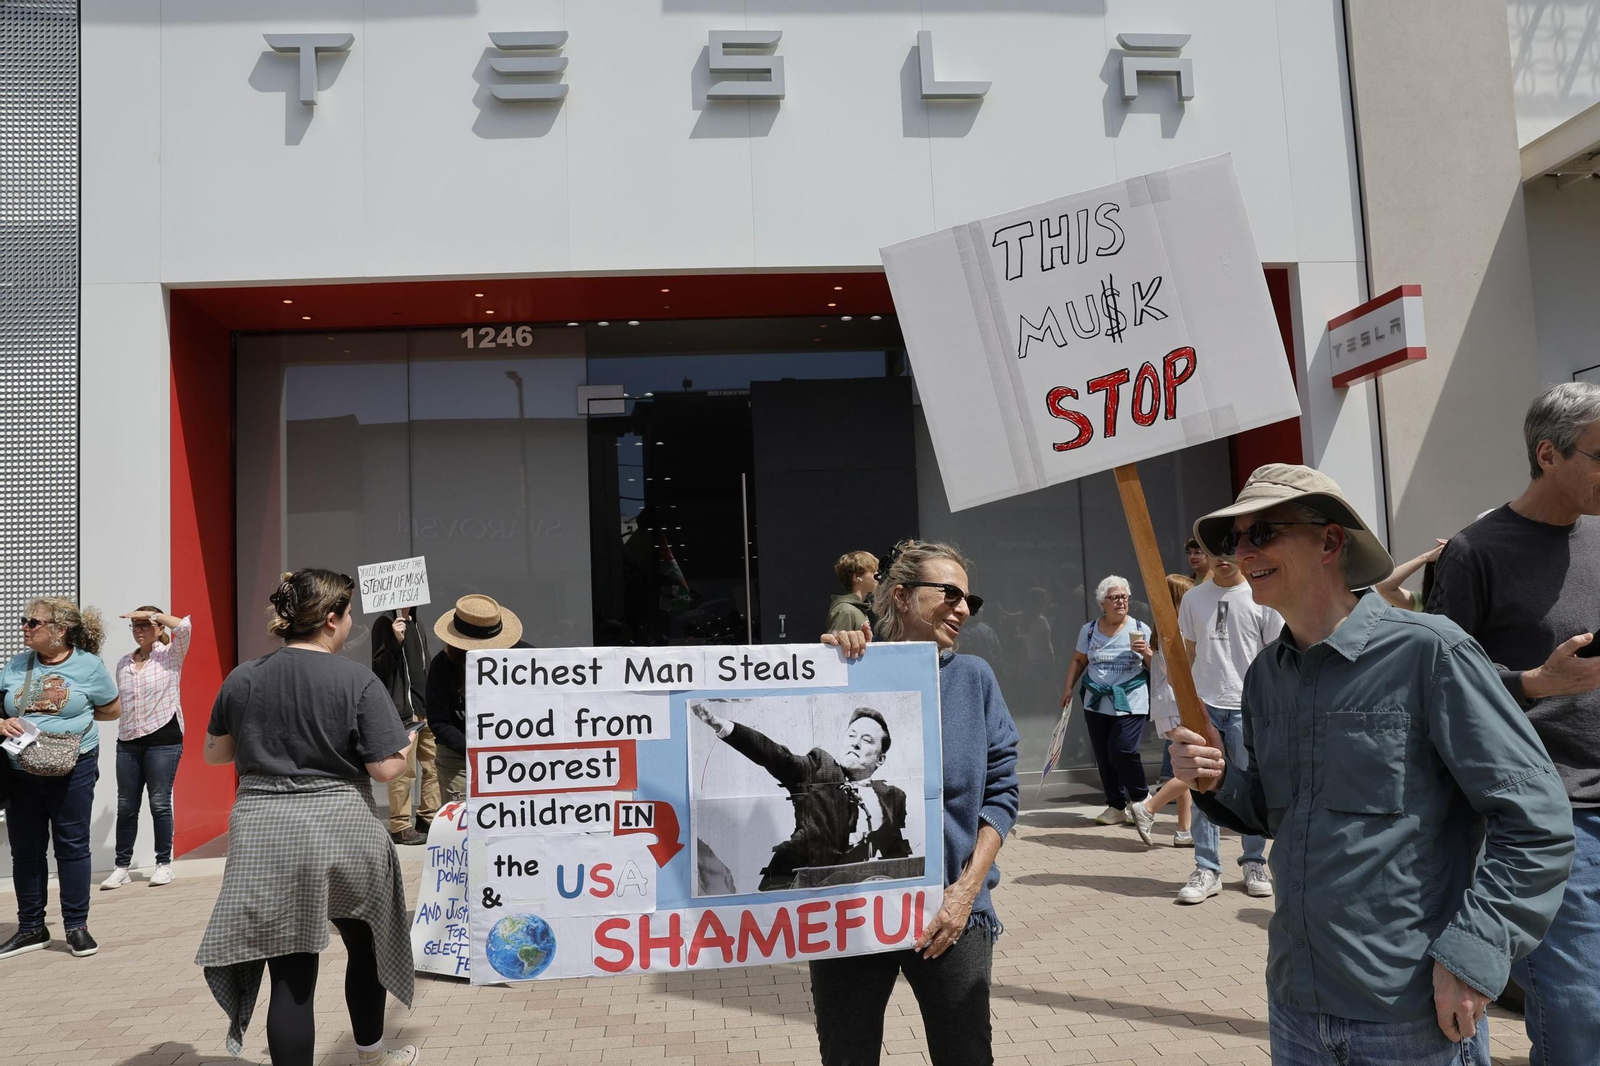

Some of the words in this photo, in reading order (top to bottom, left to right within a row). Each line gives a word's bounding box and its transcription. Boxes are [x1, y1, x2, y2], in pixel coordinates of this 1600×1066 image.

[262, 30, 1194, 106] TESLA
[992, 202, 1126, 281] THIS
[461, 326, 533, 348] 1246
[1332, 317, 1401, 358] TESLA
[1046, 346, 1197, 452] STOP
[379, 563, 396, 575] NEVER
[398, 561, 410, 571] GET
[412, 559, 423, 569] THE
[362, 575, 393, 595] STENCH
[394, 574, 405, 588] OF
[404, 570, 426, 588] MUSK
[373, 592, 388, 608] OFF
[389, 591, 395, 605] A
[398, 588, 419, 602] TESLA
[476, 657, 603, 686] Richest
[624, 657, 693, 684] Man
[718, 653, 816, 682] Steals
[476, 709, 555, 741] Food
[574, 708, 652, 738] from
[486, 750, 617, 785] Poorest
[476, 798, 611, 829] Children
[621, 805, 653, 827] IN
[493, 855, 540, 877] the
[481, 886, 503, 909] &
[416, 901, 442, 925] AND
[445, 924, 470, 941] FOR
